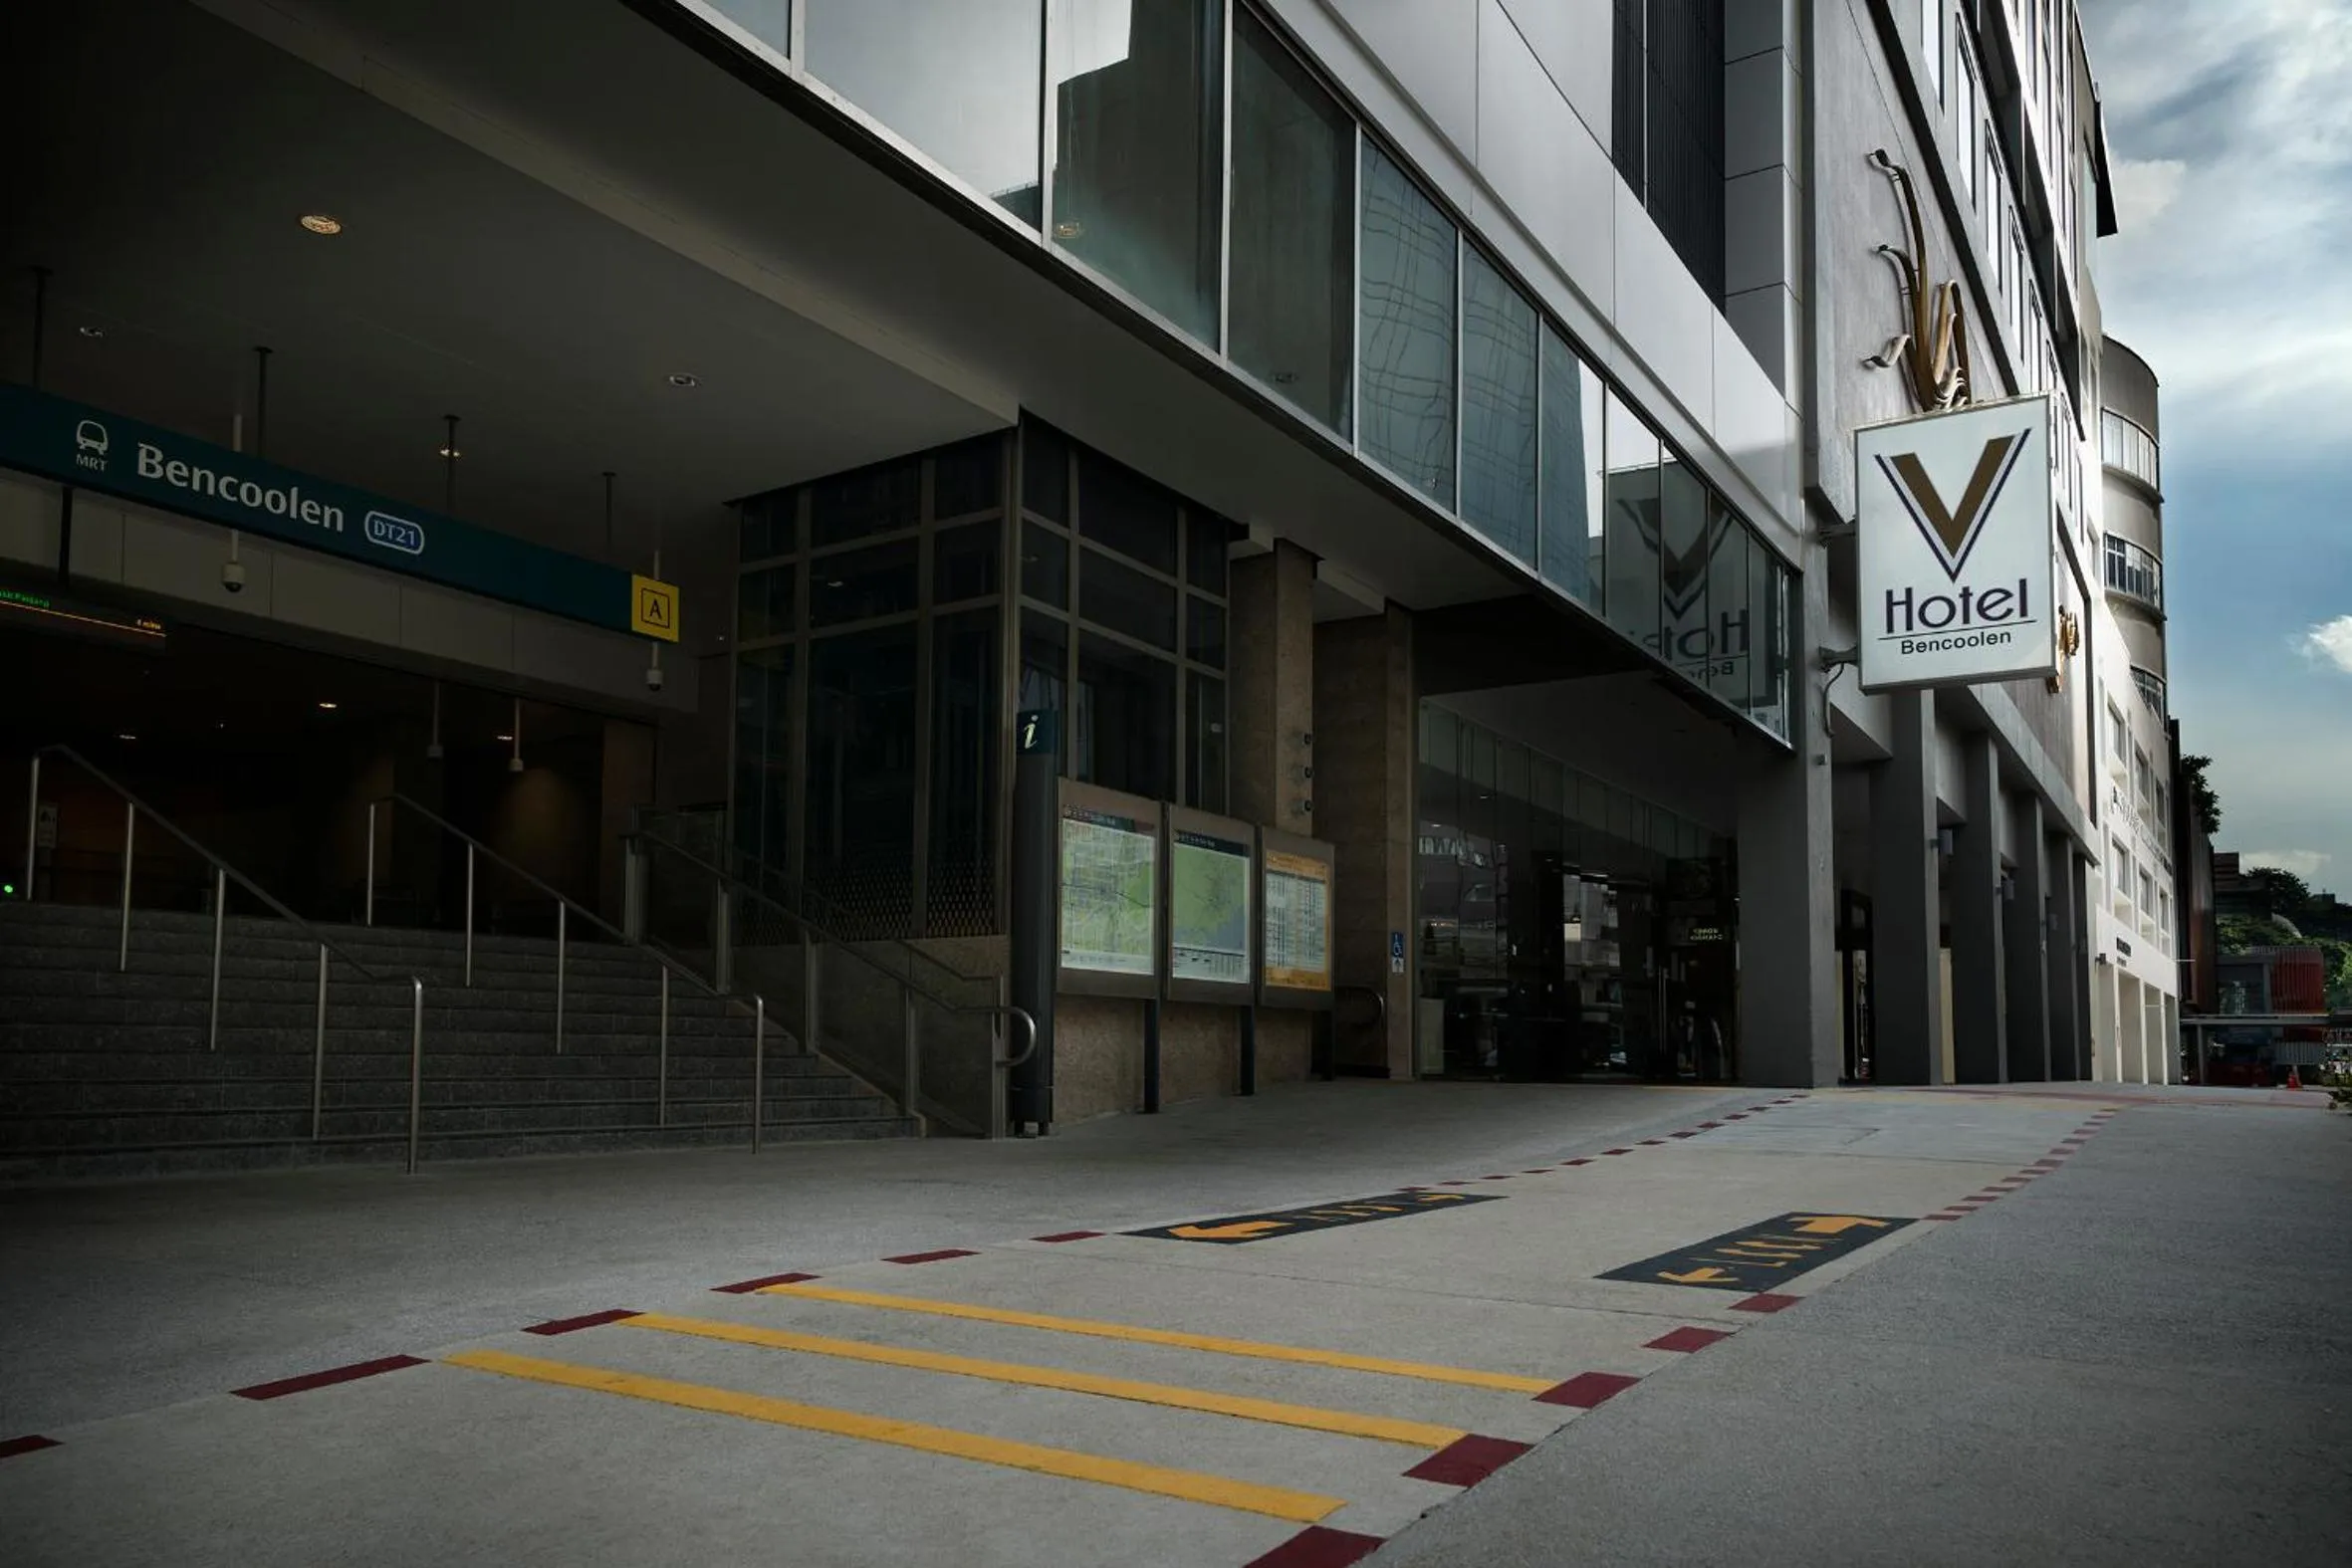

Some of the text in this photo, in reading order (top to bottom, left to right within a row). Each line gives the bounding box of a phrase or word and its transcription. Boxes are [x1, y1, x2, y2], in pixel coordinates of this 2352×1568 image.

[75, 453, 110, 473] MRT
[136, 441, 418, 548] Bencoolen DT21
[1874, 428, 2031, 583] V
[649, 598, 663, 620] A
[1885, 578, 2028, 634] Hotel
[1900, 631, 2012, 655] Bencoolen
